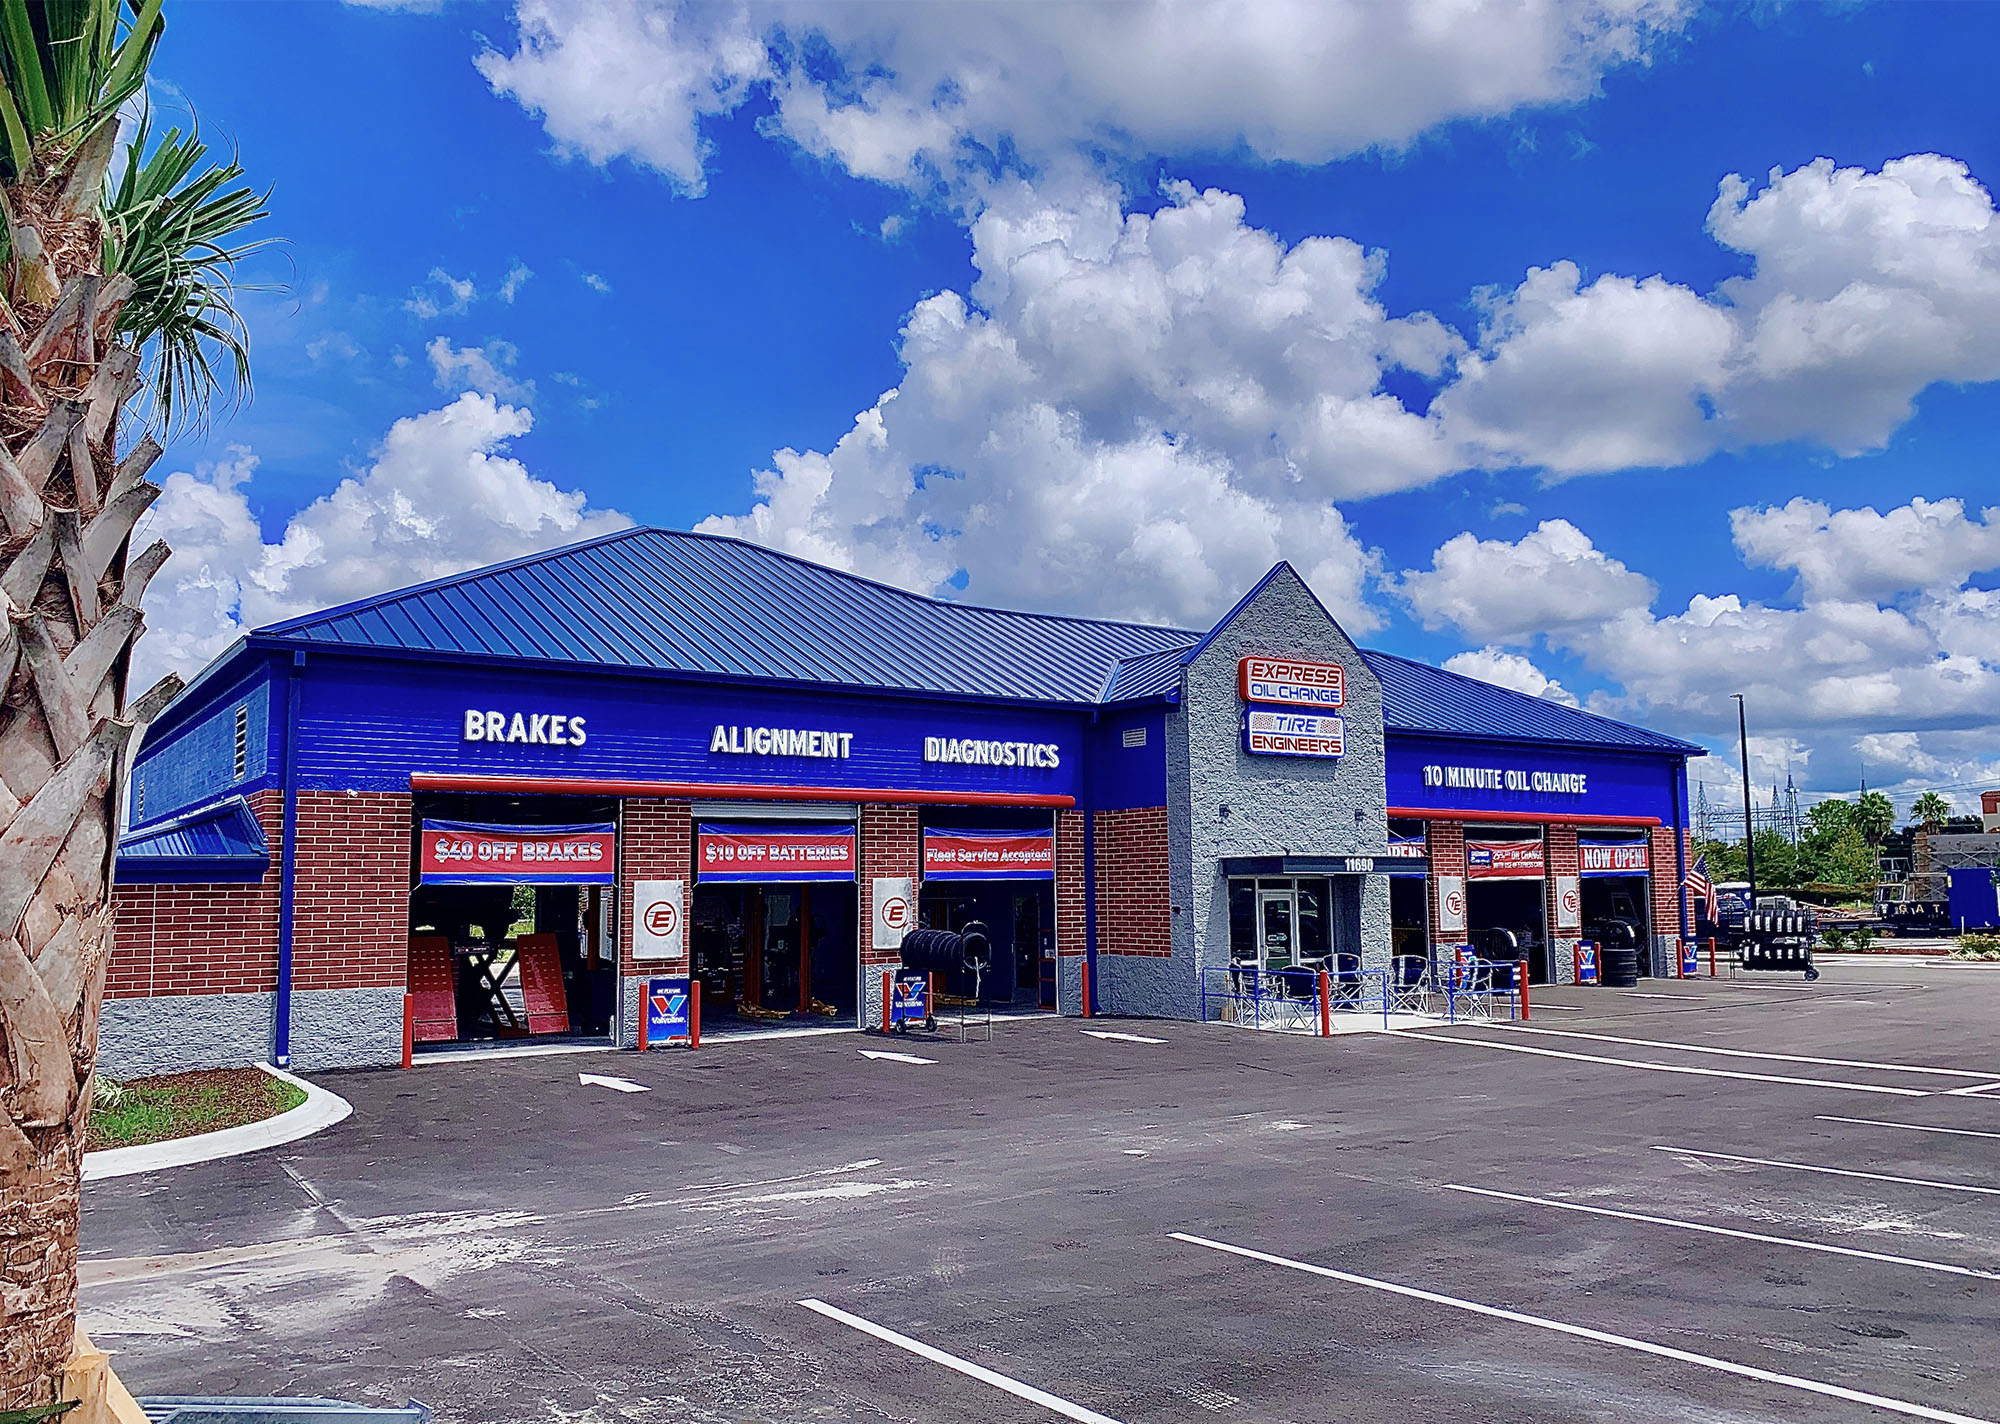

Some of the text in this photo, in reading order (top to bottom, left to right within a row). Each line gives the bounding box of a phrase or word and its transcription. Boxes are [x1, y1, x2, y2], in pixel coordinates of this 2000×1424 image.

[1251, 663, 1340, 684] EXPRESS
[1251, 683, 1340, 703] OIL CHANGE
[464, 709, 587, 747] BRAKES
[1275, 716, 1318, 733] TIRE
[710, 725, 853, 759] ALIGNMENT
[924, 736, 1060, 768] DIAGNOSTICS
[1252, 735, 1341, 753] ENGINEERS
[1423, 765, 1588, 793] 10 MINUTE OIL CHANGE
[434, 838, 603, 864] $40 OFF BRAKES
[705, 842, 849, 864] $10 OFF BATTERIES
[926, 848, 956, 862] Fleet
[957, 848, 999, 862] Service
[1584, 848, 1646, 869] NOW OPEN!
[1344, 858, 1374, 872] 11690
